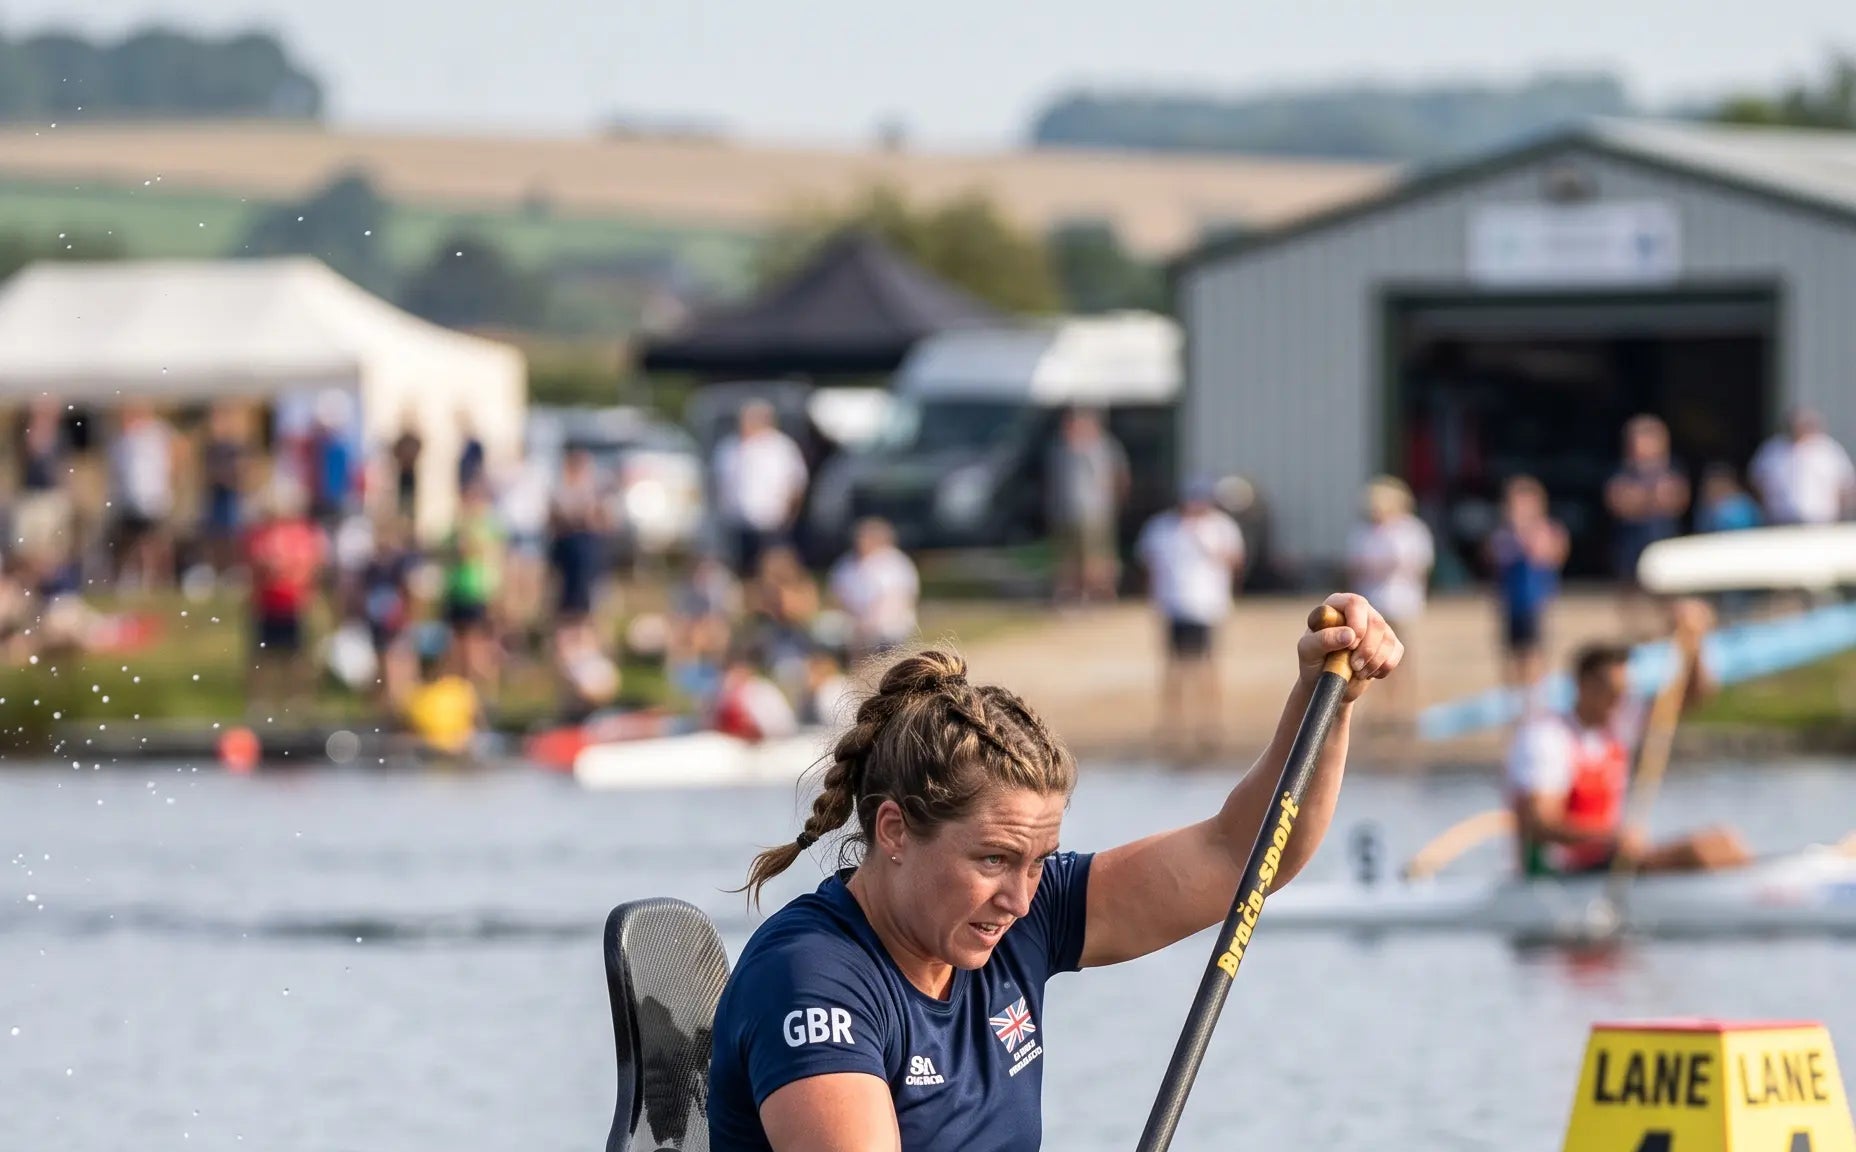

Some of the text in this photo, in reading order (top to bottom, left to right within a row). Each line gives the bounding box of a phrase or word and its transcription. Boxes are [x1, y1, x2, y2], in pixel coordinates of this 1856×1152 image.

[783, 1008, 855, 1047] GBR
[1593, 1048, 1714, 1106] LANE
[1738, 1050, 1830, 1106] LANE
